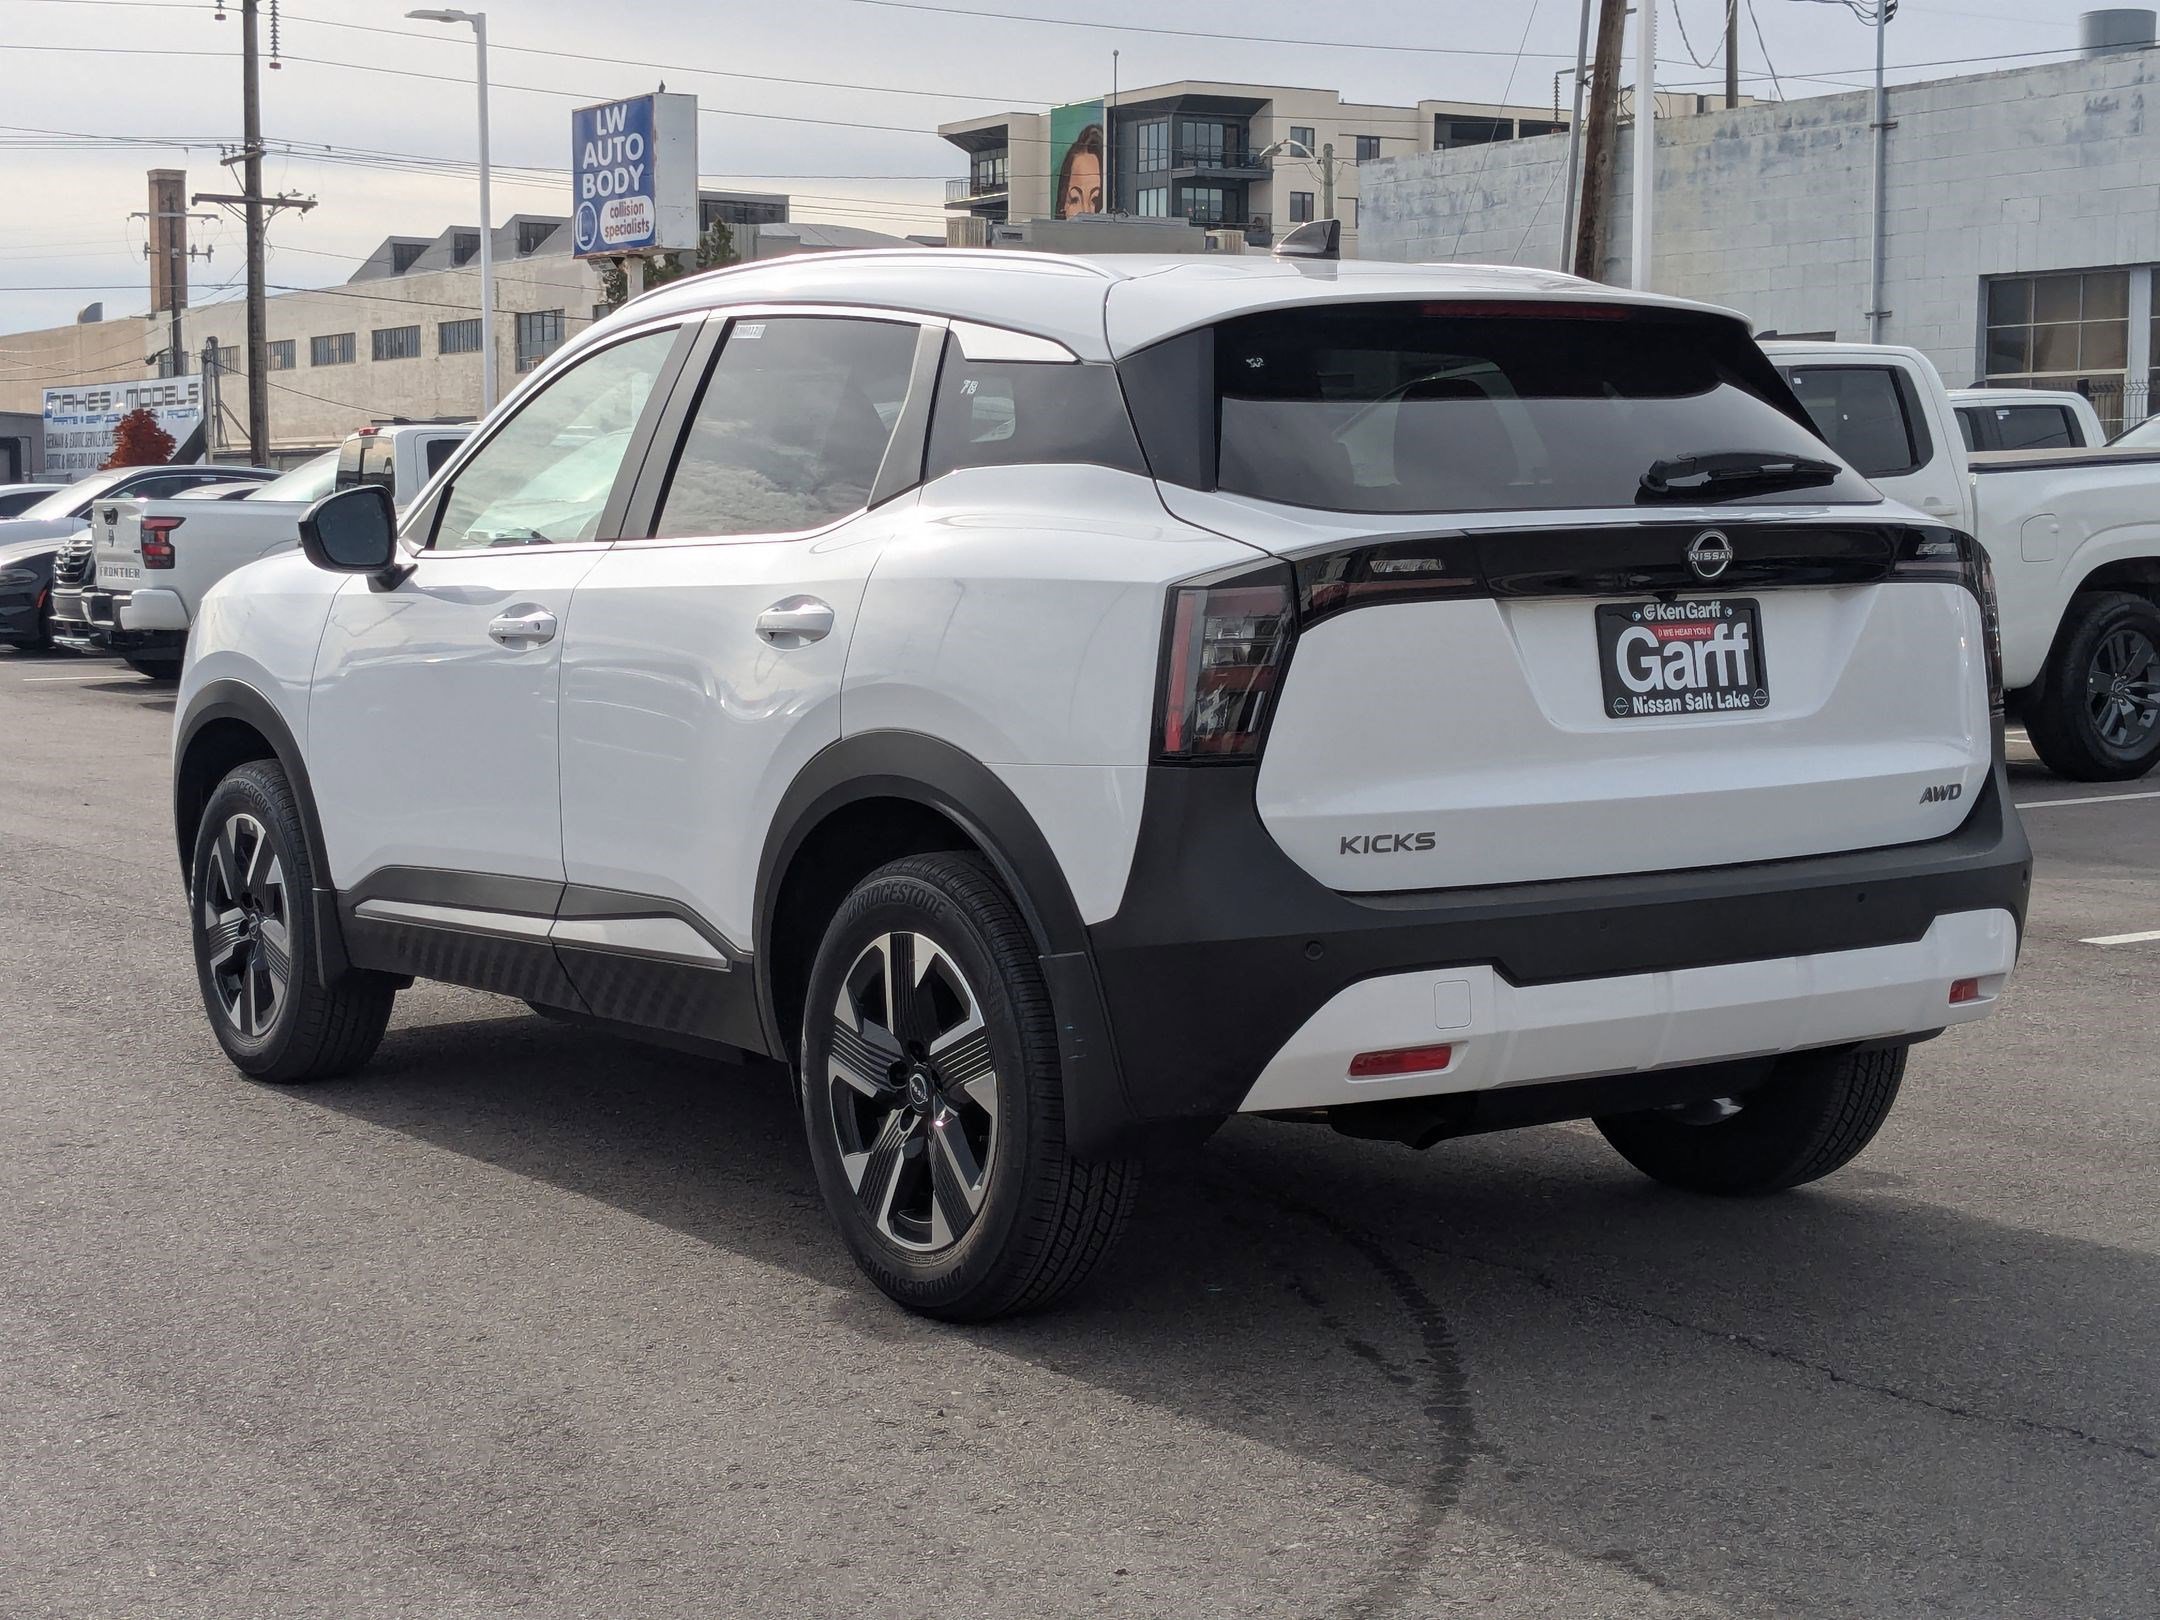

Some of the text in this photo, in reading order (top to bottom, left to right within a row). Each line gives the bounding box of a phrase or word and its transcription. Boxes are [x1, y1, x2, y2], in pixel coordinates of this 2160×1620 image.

[596, 103, 628, 136] LW
[582, 132, 644, 170] AUTO
[582, 163, 645, 199] BODY
[609, 200, 645, 219] collision
[604, 218, 650, 241] specialists
[49, 389, 112, 415] MAKES
[125, 382, 200, 412] MODELS
[1689, 551, 1732, 561] NISSAN
[99, 566, 141, 579] FRONTIER
[1686, 601, 1721, 620] Garff
[1662, 626, 1707, 637] WE HEAR YOU
[1616, 622, 1749, 693] Garff
[1632, 690, 1751, 714] Nissan Salt Lake
[1919, 783, 1962, 804] AWD
[1340, 831, 1436, 855] KICKS
[848, 879, 947, 925] BRIDGESTONE
